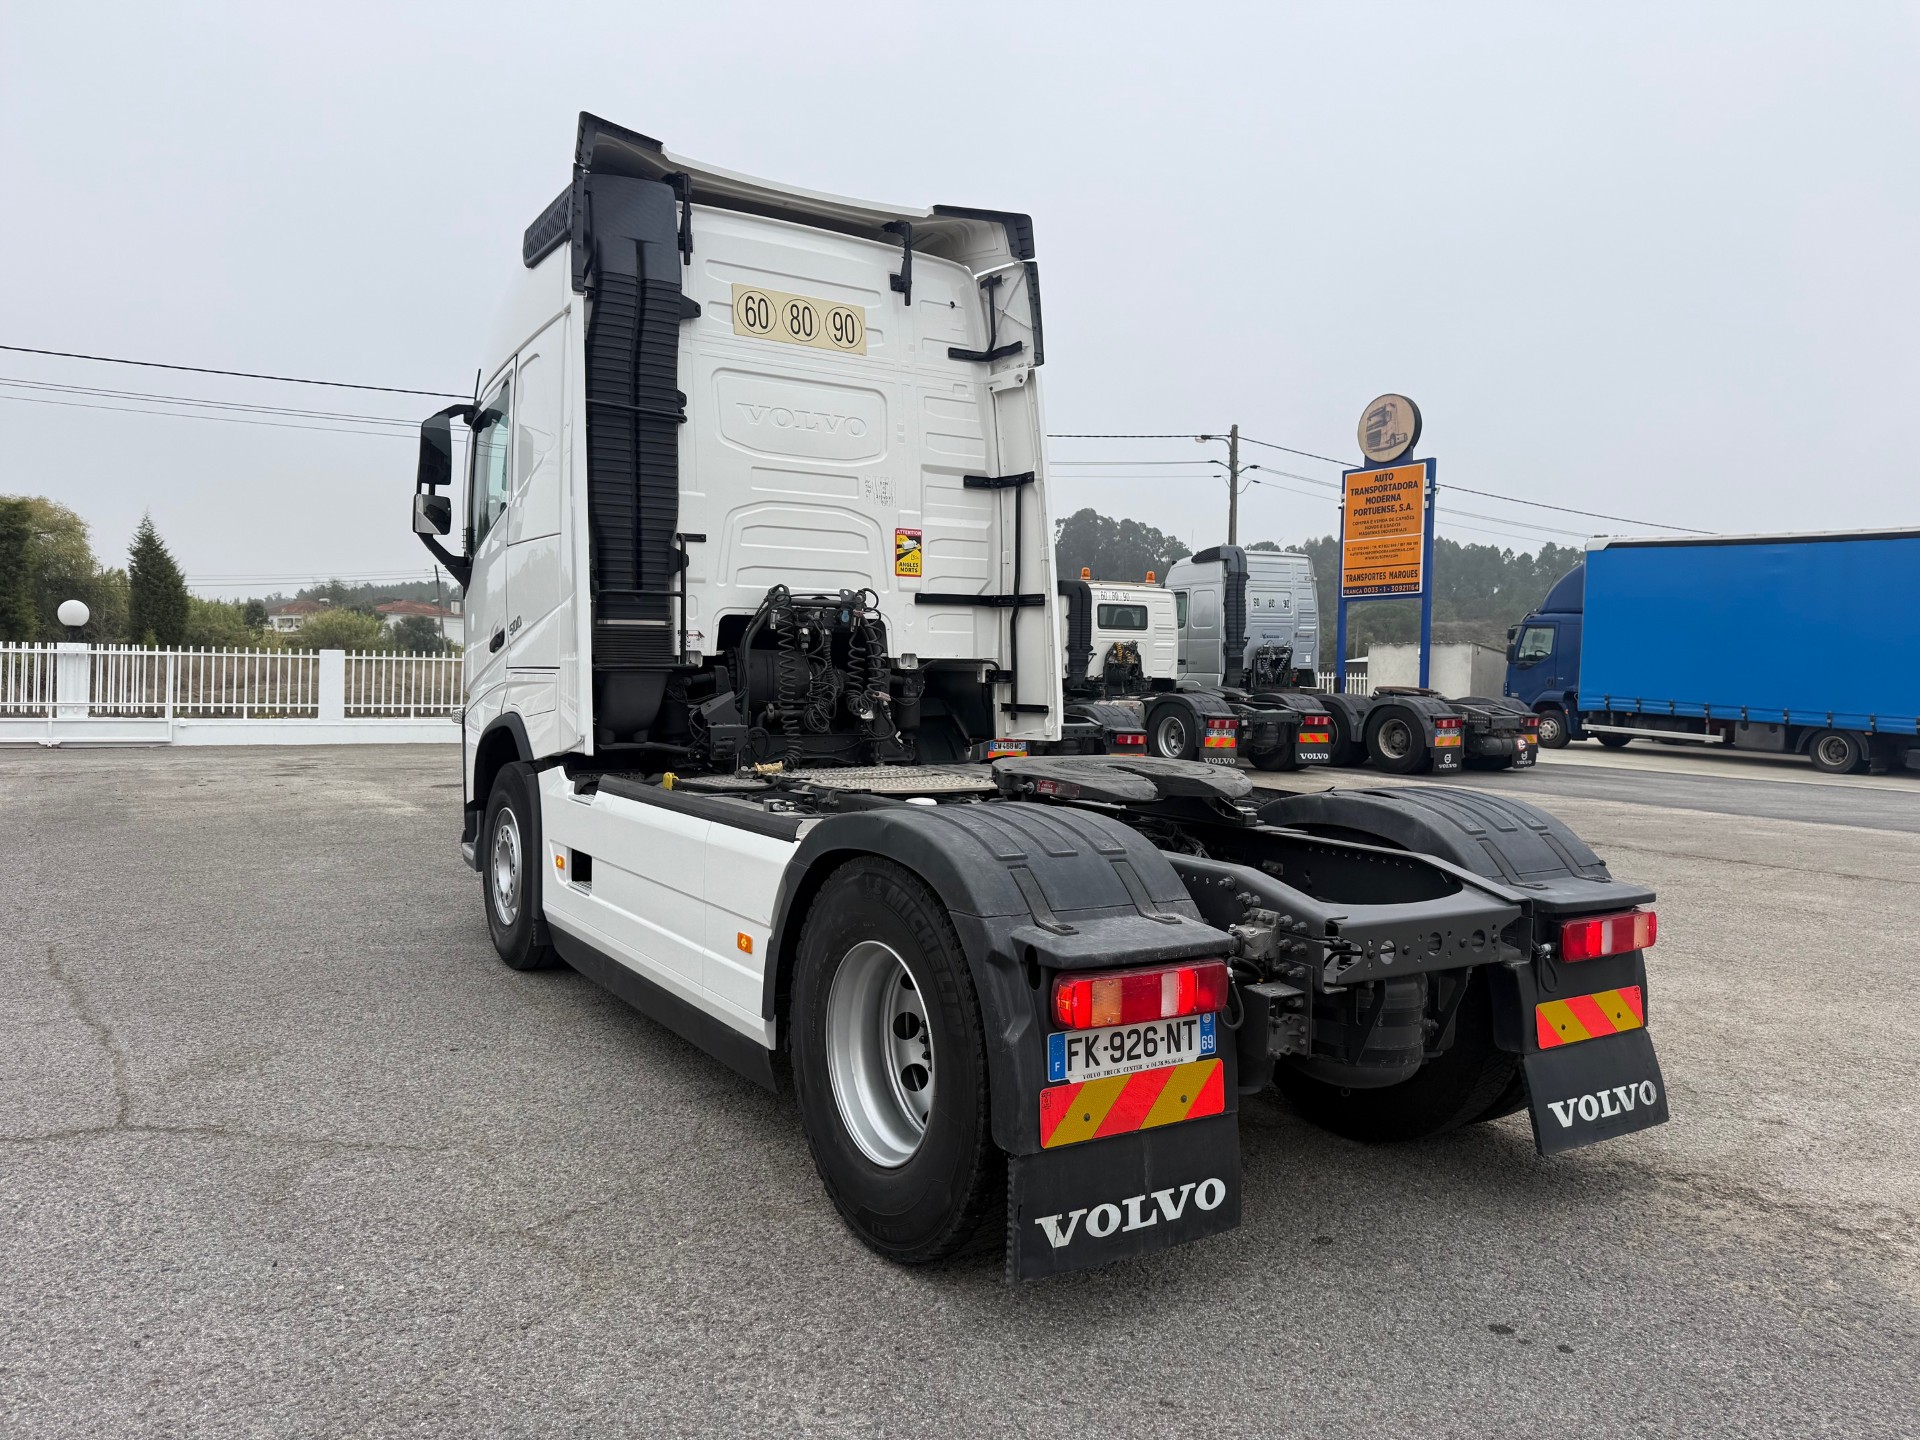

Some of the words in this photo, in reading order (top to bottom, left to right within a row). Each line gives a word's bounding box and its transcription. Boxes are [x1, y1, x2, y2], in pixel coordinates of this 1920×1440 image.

[745, 295, 769, 330] 60
[790, 303, 813, 337] 80
[832, 311, 855, 344] 90
[736, 402, 867, 438] VOLVO
[1374, 472, 1394, 482] AUTO
[1350, 480, 1418, 496] TRANSPORTADORA
[1365, 494, 1401, 505] MODERNA
[1353, 505, 1398, 516] PORTUENSE,
[1399, 503, 1414, 512] S.A.
[1346, 572, 1386, 582] TRANSPORTES
[1389, 570, 1418, 579] MARQUES
[1100, 591, 1108, 600] 60
[509, 614, 522, 637] 500
[1068, 1019, 1197, 1072] FK-926-NT
[1201, 1034, 1214, 1050] 69
[1054, 1061, 1060, 1072] F
[1082, 1071, 1100, 1080] VOLVO
[1104, 1067, 1121, 1077] TRUCK
[1123, 1064, 1143, 1074] CENTER
[1548, 1080, 1657, 1128] VOLVO
[1034, 1178, 1226, 1248] VOLVO
